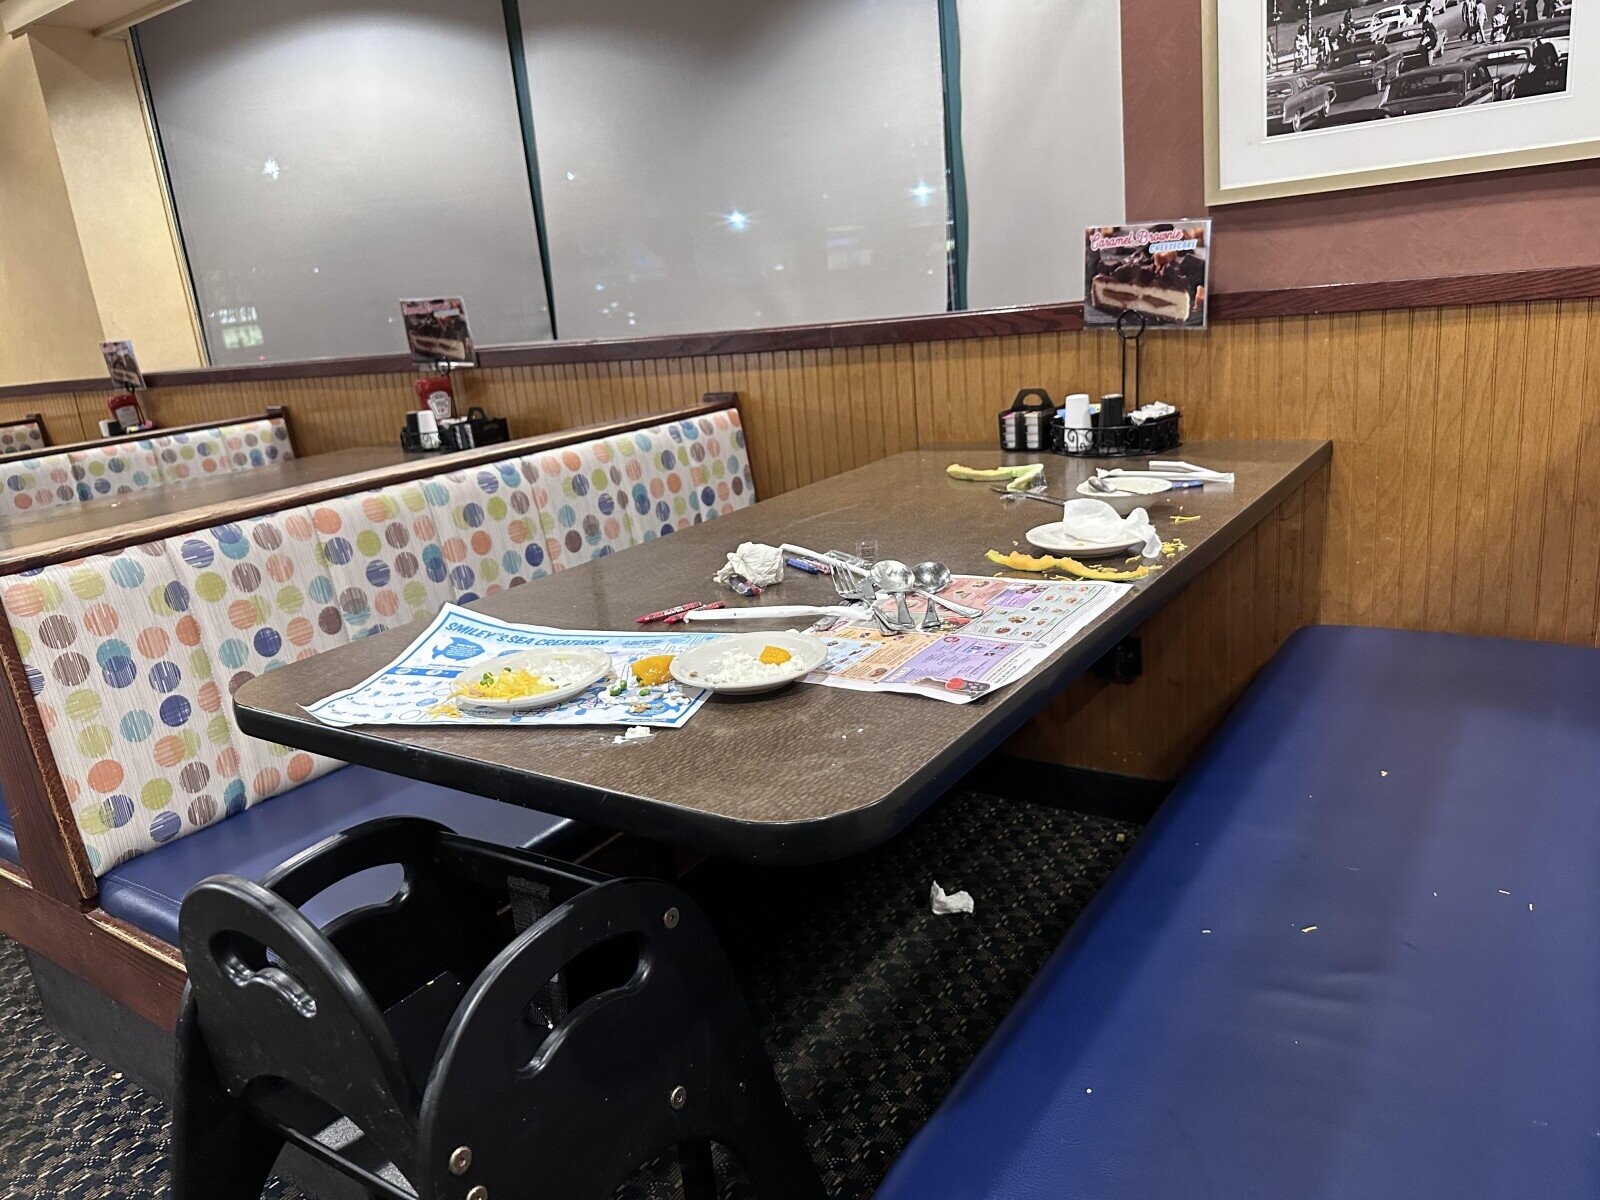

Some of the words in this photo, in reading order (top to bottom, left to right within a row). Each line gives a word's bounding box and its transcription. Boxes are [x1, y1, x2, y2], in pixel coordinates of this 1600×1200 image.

[1091, 232, 1132, 250] Caramel
[1135, 230, 1182, 245] Brownie
[507, 635, 535, 645] SEA
